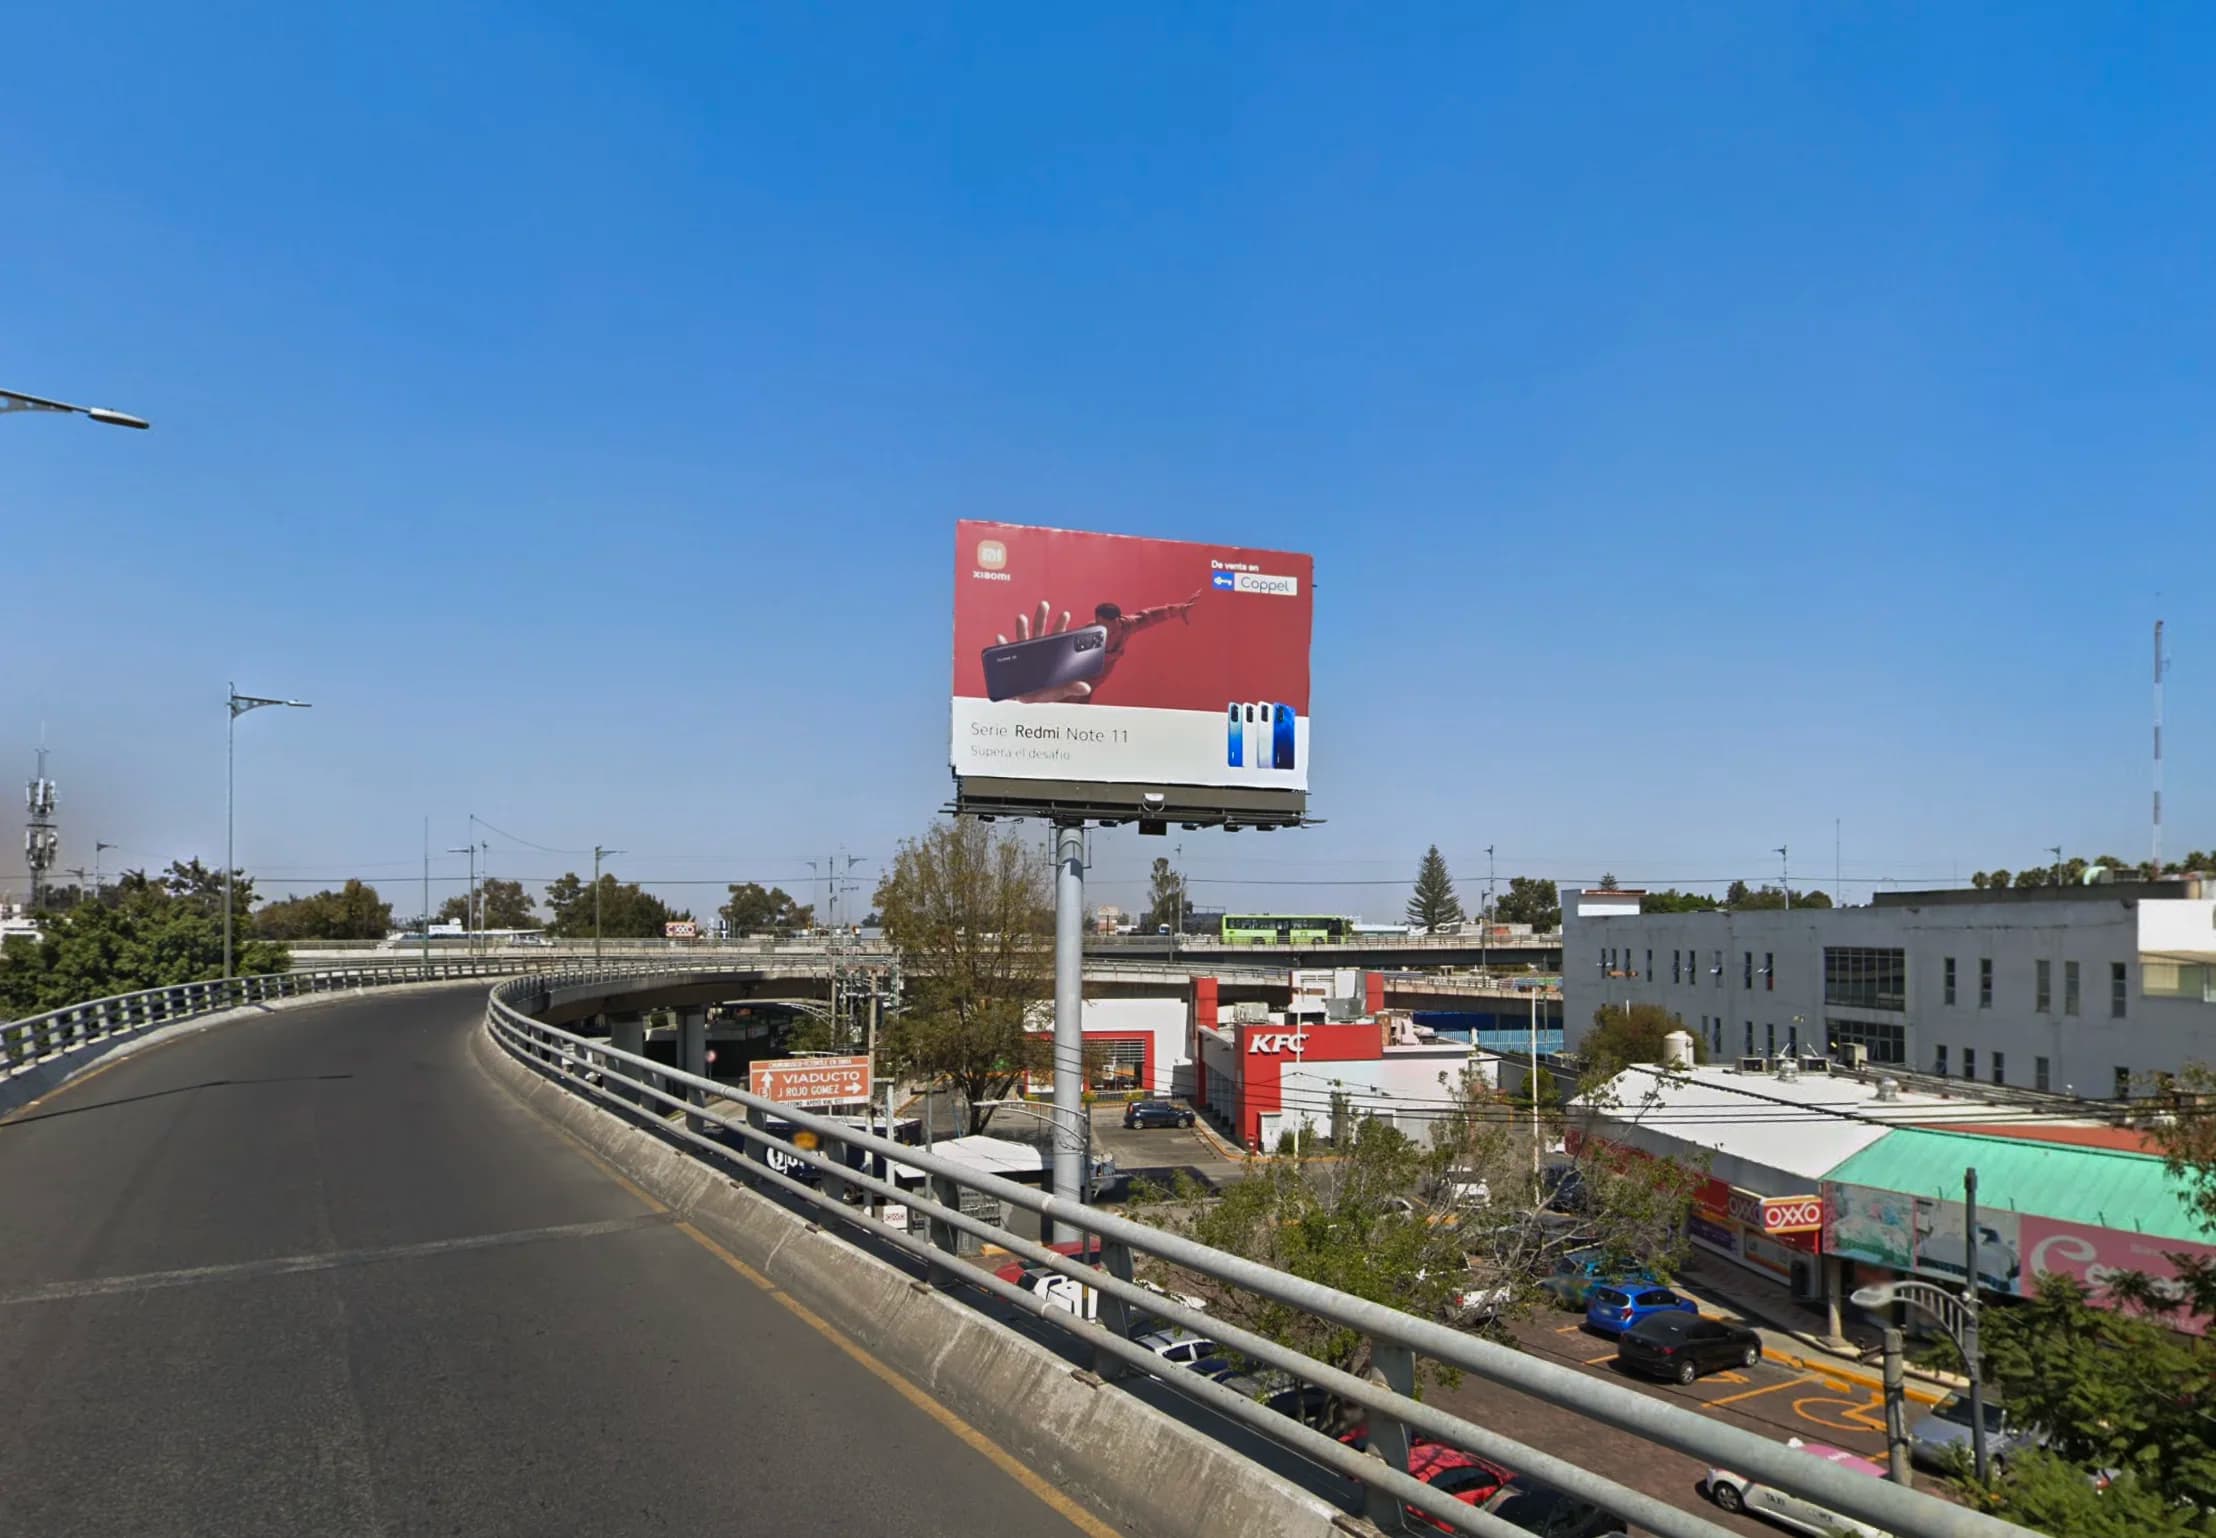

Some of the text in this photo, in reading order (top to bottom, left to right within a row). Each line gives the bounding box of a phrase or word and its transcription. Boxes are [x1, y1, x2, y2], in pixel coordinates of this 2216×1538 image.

[1211, 560, 1223, 569] De
[1225, 563, 1247, 571] venta
[1241, 576, 1290, 594] Coppel
[971, 722, 1128, 743] Serie Redmi Note 11
[1248, 1033, 1310, 1054] KFC
[782, 1071, 860, 1084] VIADUCTO
[786, 1087, 808, 1096] ROJO
[811, 1084, 839, 1095] GOMEZ
[1765, 1202, 1820, 1228] OXXO
